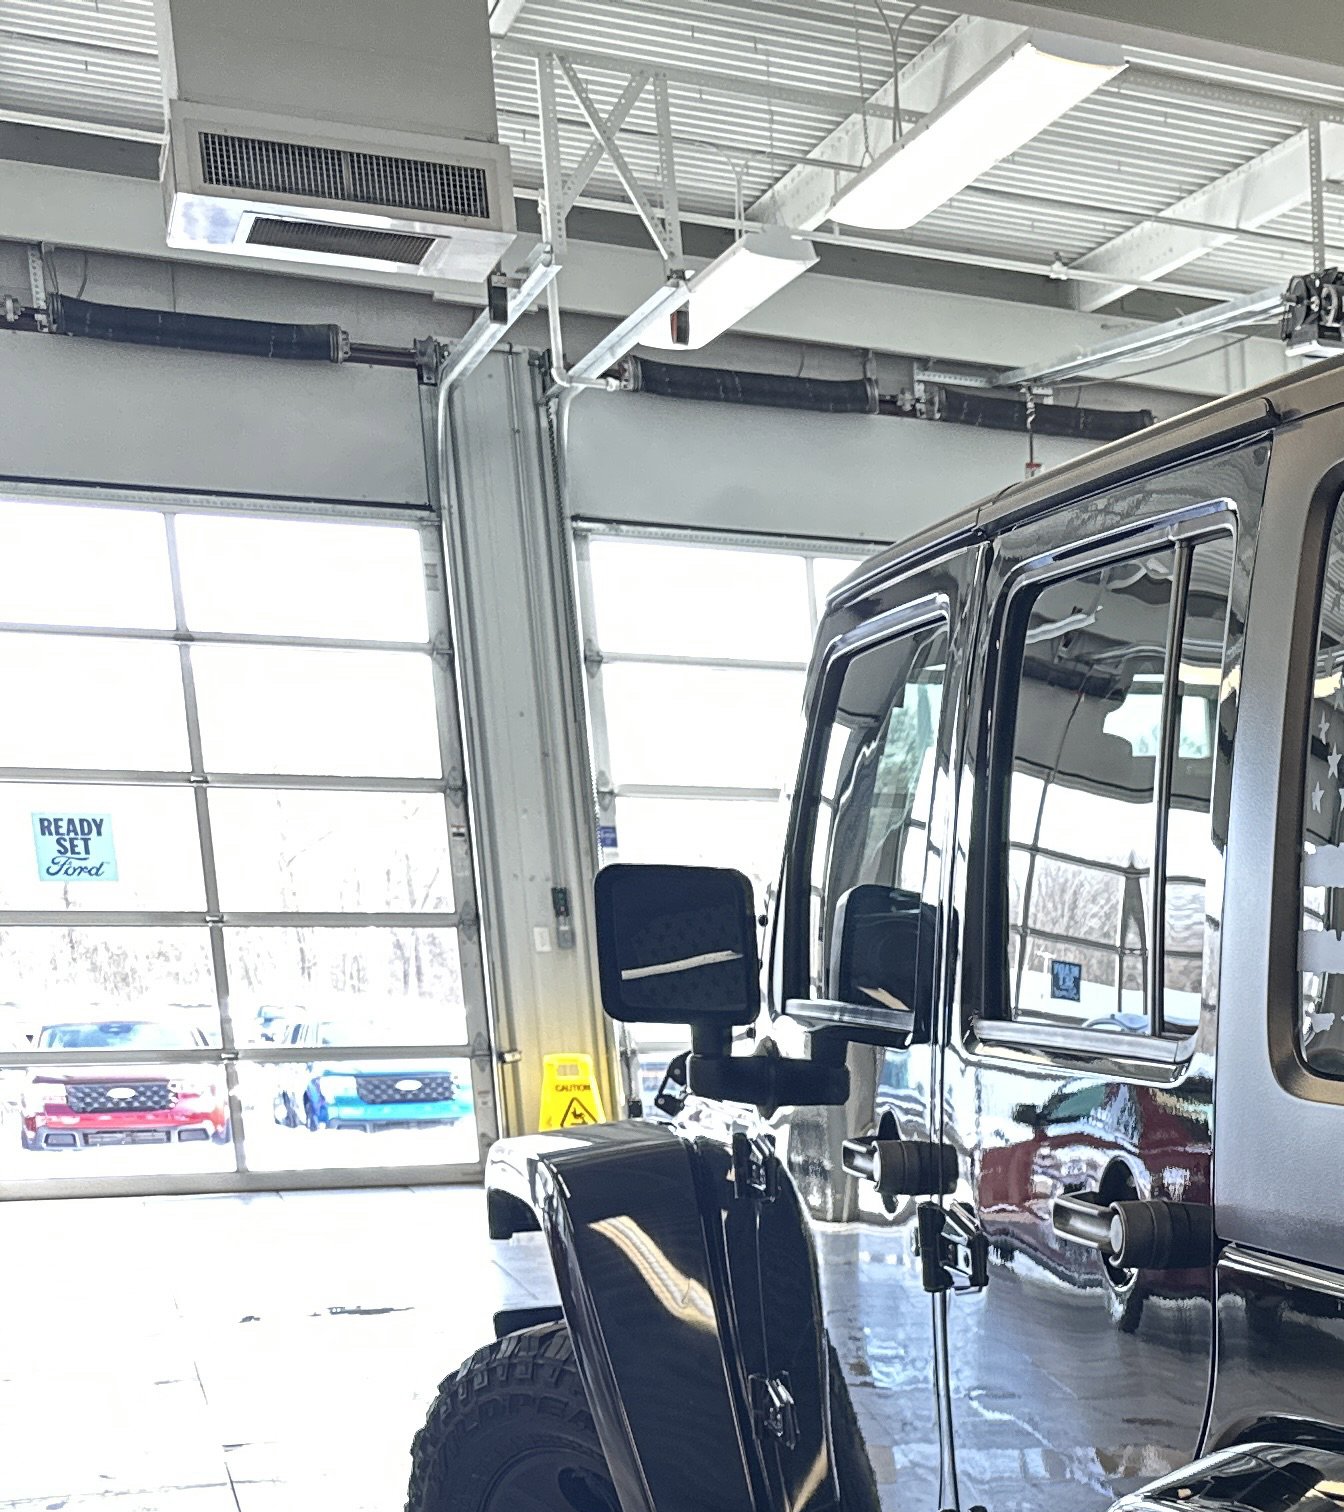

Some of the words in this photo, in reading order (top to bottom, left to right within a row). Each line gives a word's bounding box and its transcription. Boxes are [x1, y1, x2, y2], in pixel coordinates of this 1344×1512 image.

[39, 817, 104, 836] READY
[56, 837, 91, 855] SET
[46, 855, 105, 876] Ford
[555, 1083, 591, 1092] CAUTION
